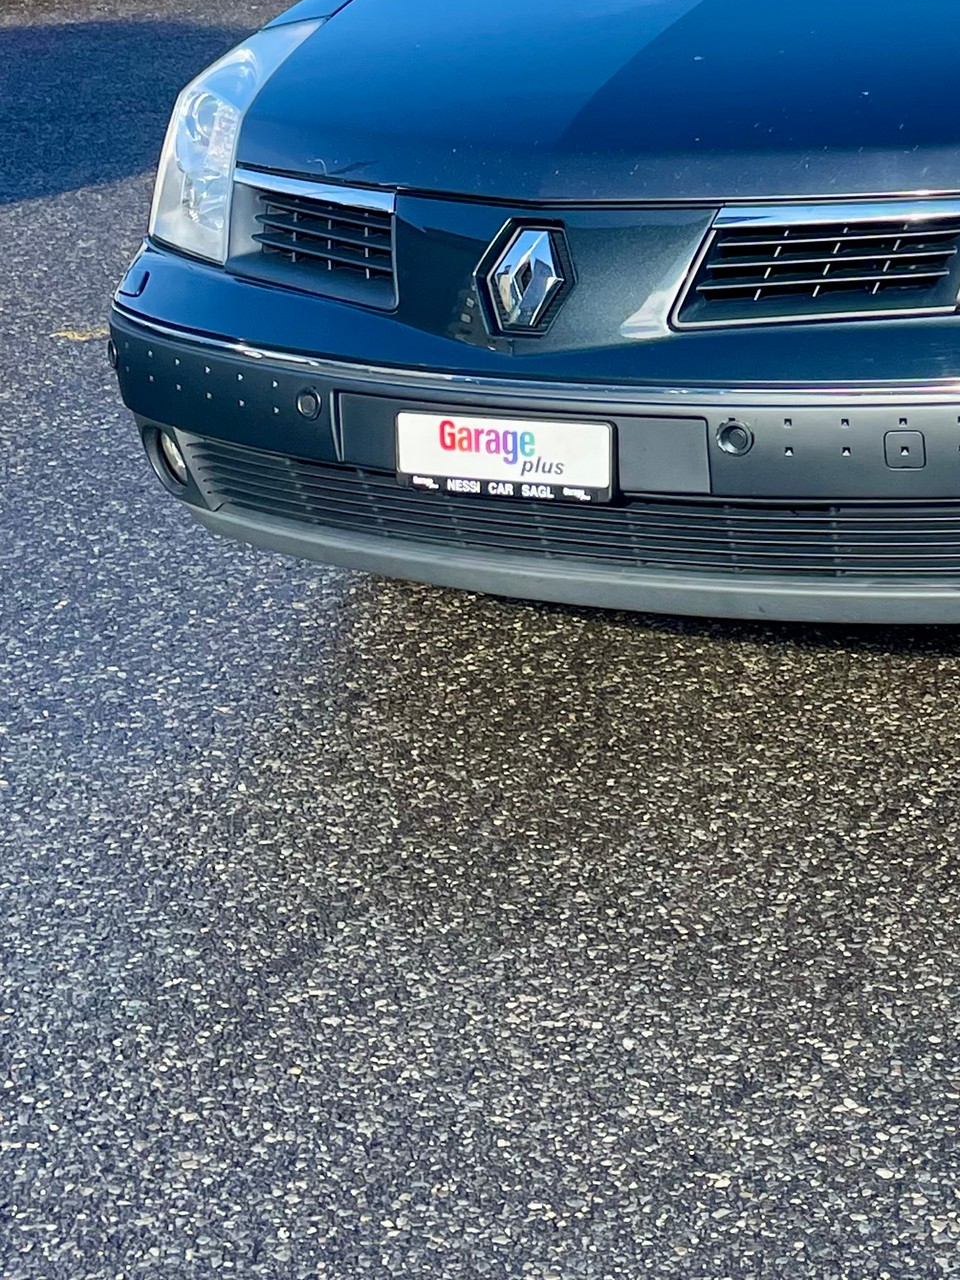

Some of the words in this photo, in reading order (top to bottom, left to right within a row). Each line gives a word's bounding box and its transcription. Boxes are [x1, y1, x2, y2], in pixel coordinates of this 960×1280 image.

[439, 420, 536, 465] Garage
[520, 456, 565, 476] plus
[447, 479, 481, 494] NESSI
[488, 482, 514, 496] CAR
[521, 484, 555, 499] SAGL
